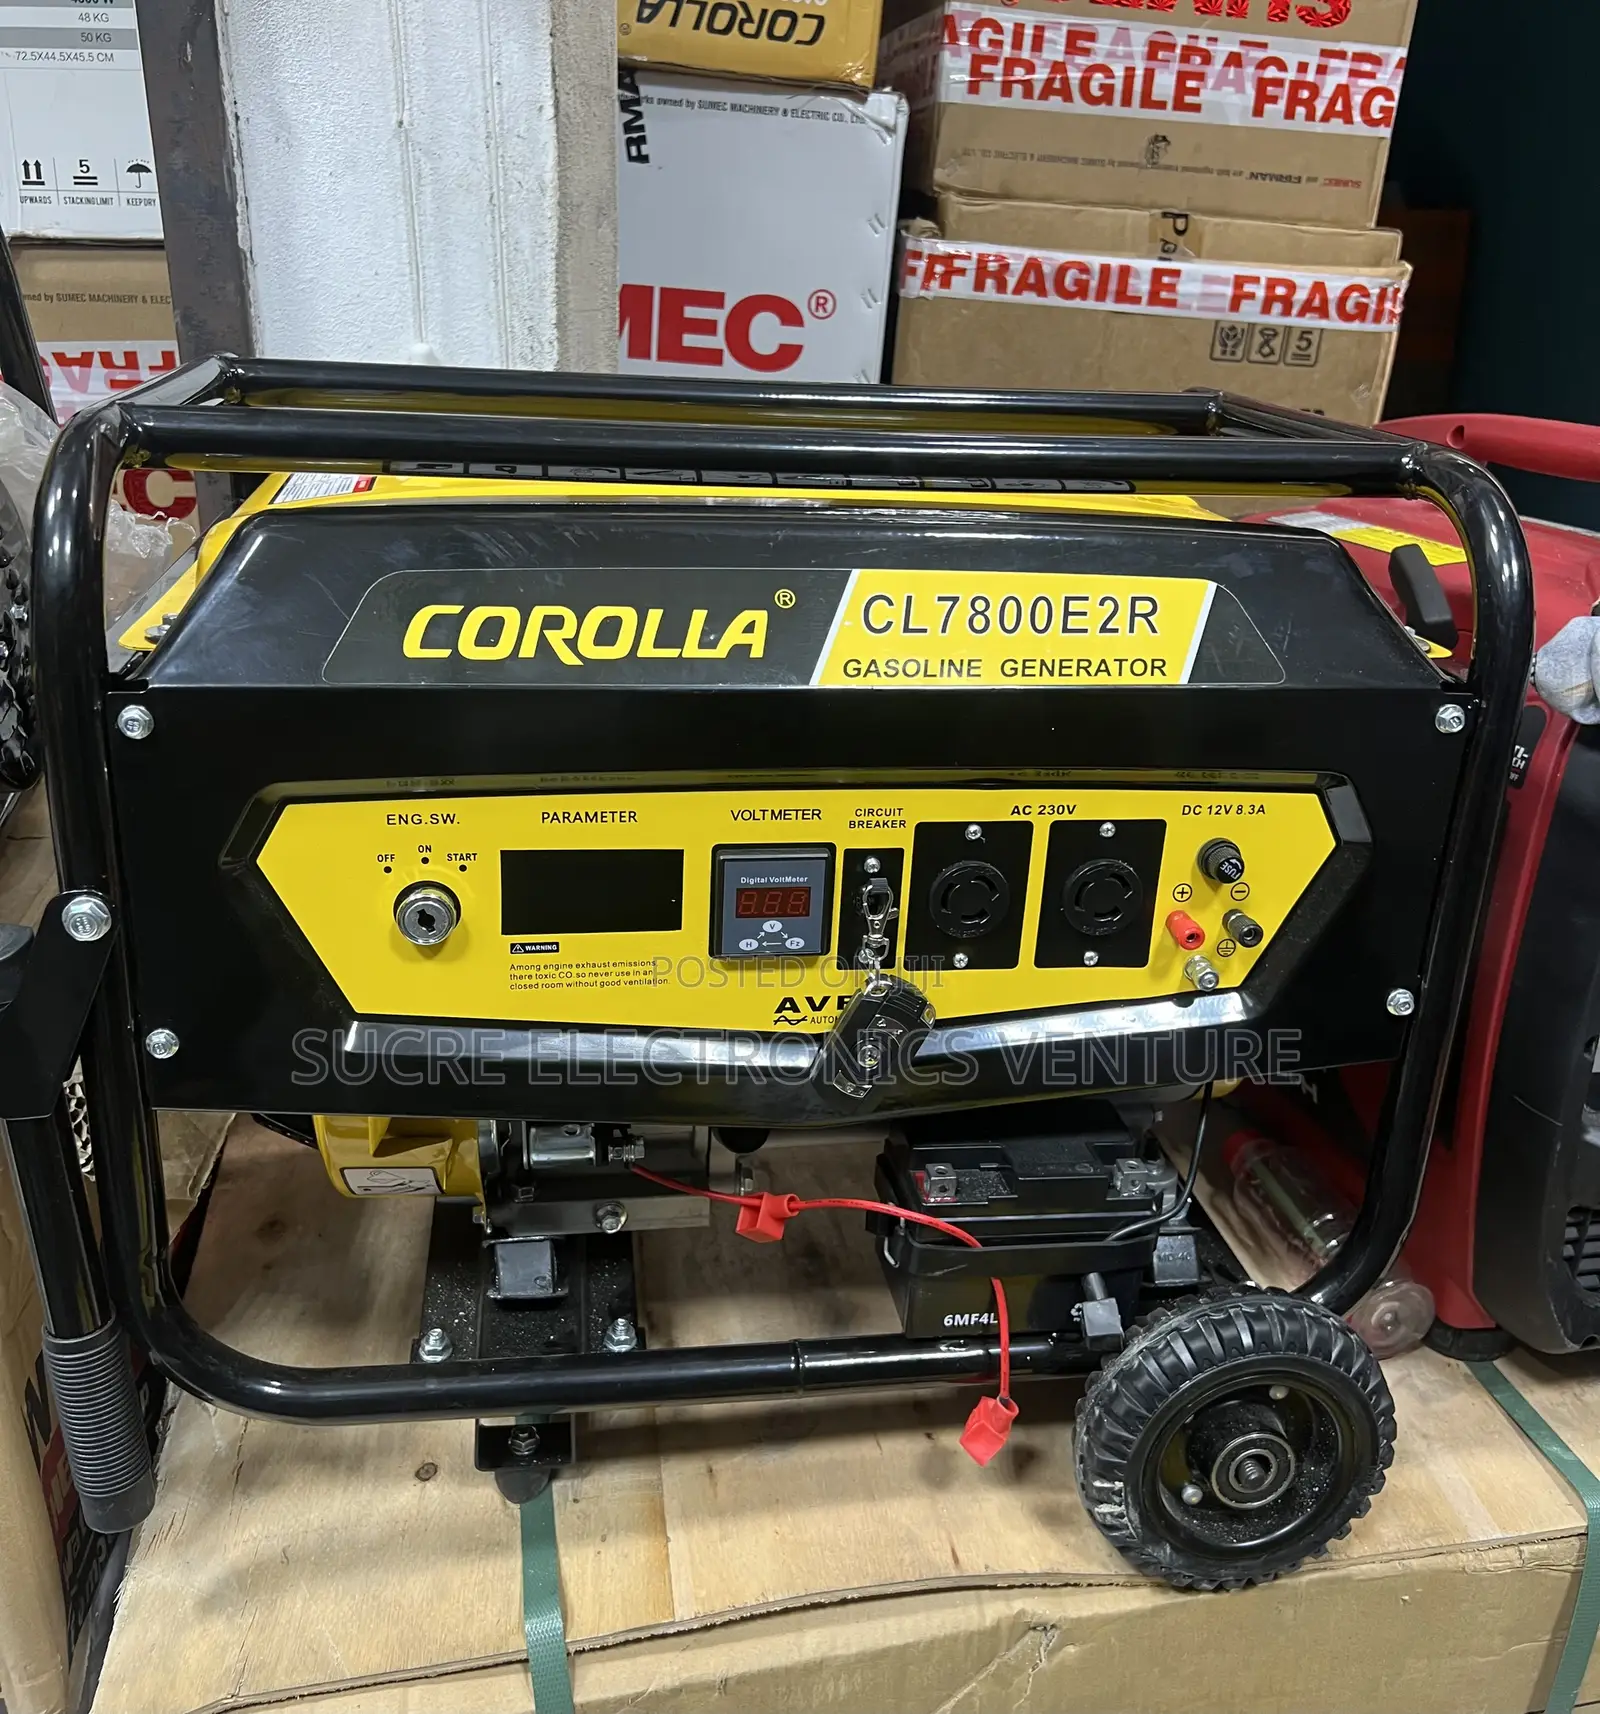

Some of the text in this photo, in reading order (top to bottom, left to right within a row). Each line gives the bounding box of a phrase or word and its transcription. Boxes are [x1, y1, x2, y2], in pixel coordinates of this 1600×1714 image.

[78, 12, 110, 23] 48 KG
[80, 32, 112, 43] 50 KG
[15, 51, 115, 62] 72.5X44.5X45.5 CM
[967, 54, 1206, 114] FRAGILE
[656, 97, 684, 108] owned
[685, 98, 696, 110] by
[697, 100, 728, 111] SUMEC
[729, 103, 780, 116] MACHINERY
[790, 108, 831, 121] ELECTRIC
[20, 196, 52, 205] UPWARDS
[939, 250, 1182, 307] FRAGILE
[44, 292, 54, 304] by
[56, 292, 87, 303] SUMEC
[88, 293, 139, 304] MACHINERY
[862, 594, 1160, 635] CL7800E2R
[402, 604, 769, 666] COROLLA
[843, 658, 1167, 679] GASOLINE GENERATOR
[854, 808, 904, 818] CIRCUIT
[1010, 804, 1077, 816] AC 230V
[1181, 804, 1266, 816] DC 12V 8.3A
[386, 813, 461, 826] ENG.SW.
[541, 811, 638, 824] PARAMETER
[848, 819, 907, 829] BREAKER
[417, 844, 432, 853] ON
[376, 854, 396, 863] OFF
[446, 853, 478, 862] START
[1220, 861, 1241, 880] FUSE
[740, 877, 767, 885] Digital
[510, 963, 541, 972] Among
[543, 962, 573, 972] engine
[575, 960, 610, 970] exhaust
[510, 972, 533, 981] there
[510, 982, 539, 990] closed
[566, 980, 598, 988] without
[599, 979, 621, 988] good
